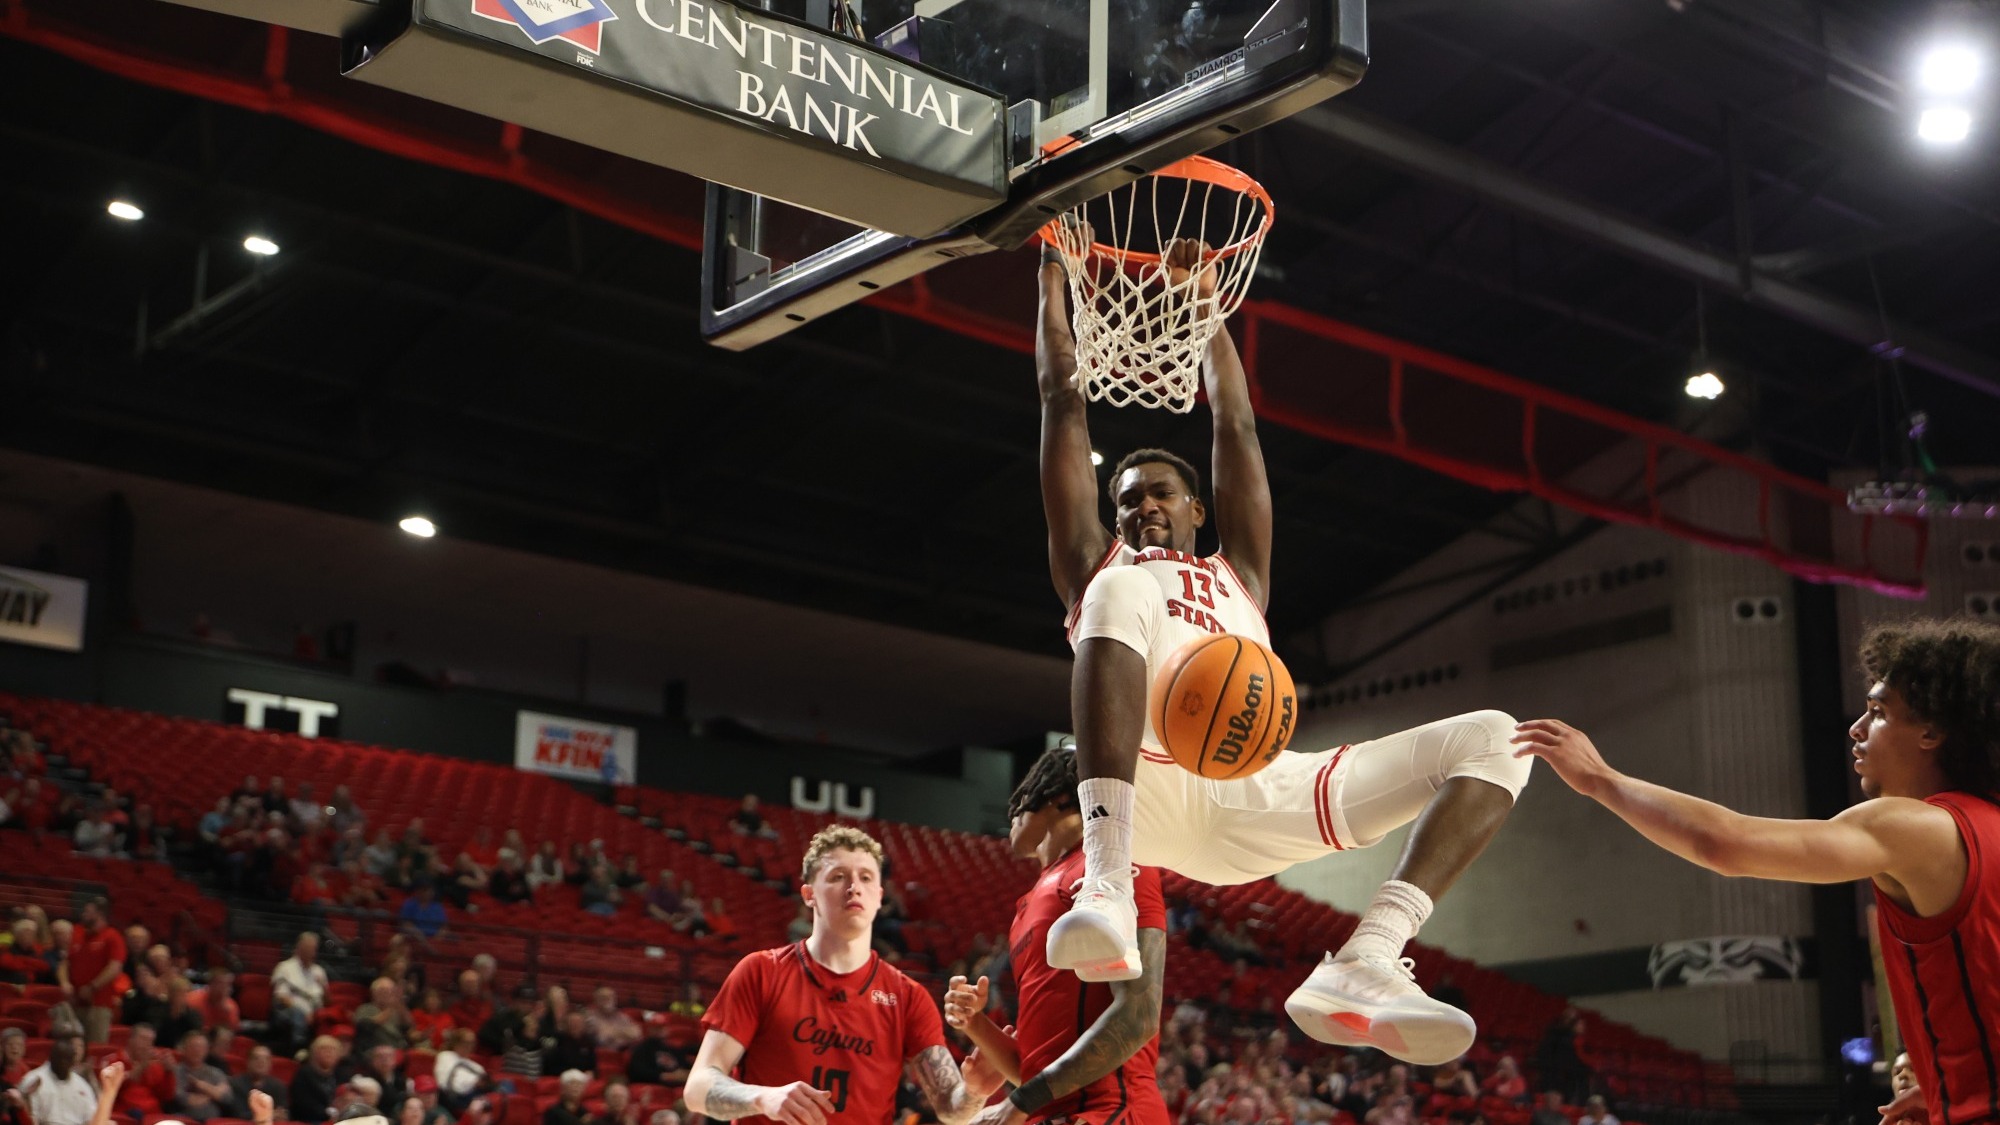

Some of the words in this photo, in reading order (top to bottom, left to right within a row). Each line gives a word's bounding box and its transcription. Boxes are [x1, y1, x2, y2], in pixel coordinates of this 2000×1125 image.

[576, 55, 594, 68] FDIC
[635, 0, 973, 136] CENTENNIAL
[735, 70, 882, 159] BANK
[1177, 570, 1215, 610] 13
[1166, 598, 1227, 634] STAT
[227, 687, 339, 738] TT
[1211, 673, 1264, 765] Wilson
[1262, 695, 1293, 762] NCAA
[790, 776, 875, 821] UU
[792, 1015, 875, 1056] Cajuns
